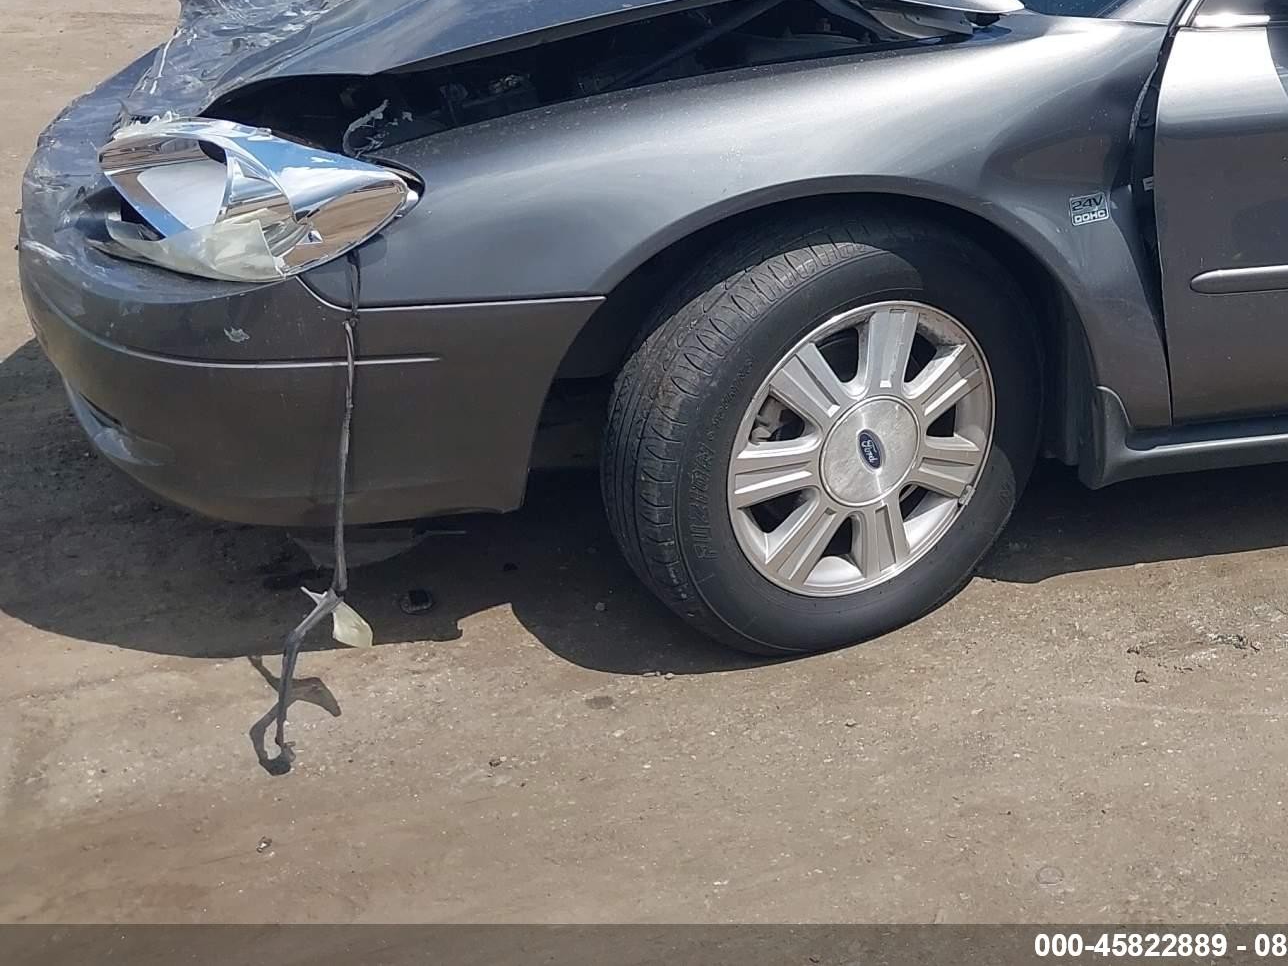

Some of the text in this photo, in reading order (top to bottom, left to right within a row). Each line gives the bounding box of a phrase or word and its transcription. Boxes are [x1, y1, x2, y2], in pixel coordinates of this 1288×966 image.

[1071, 194, 1103, 212] 24V
[1074, 210, 1106, 223] DOHC
[860, 438, 879, 464] Ford
